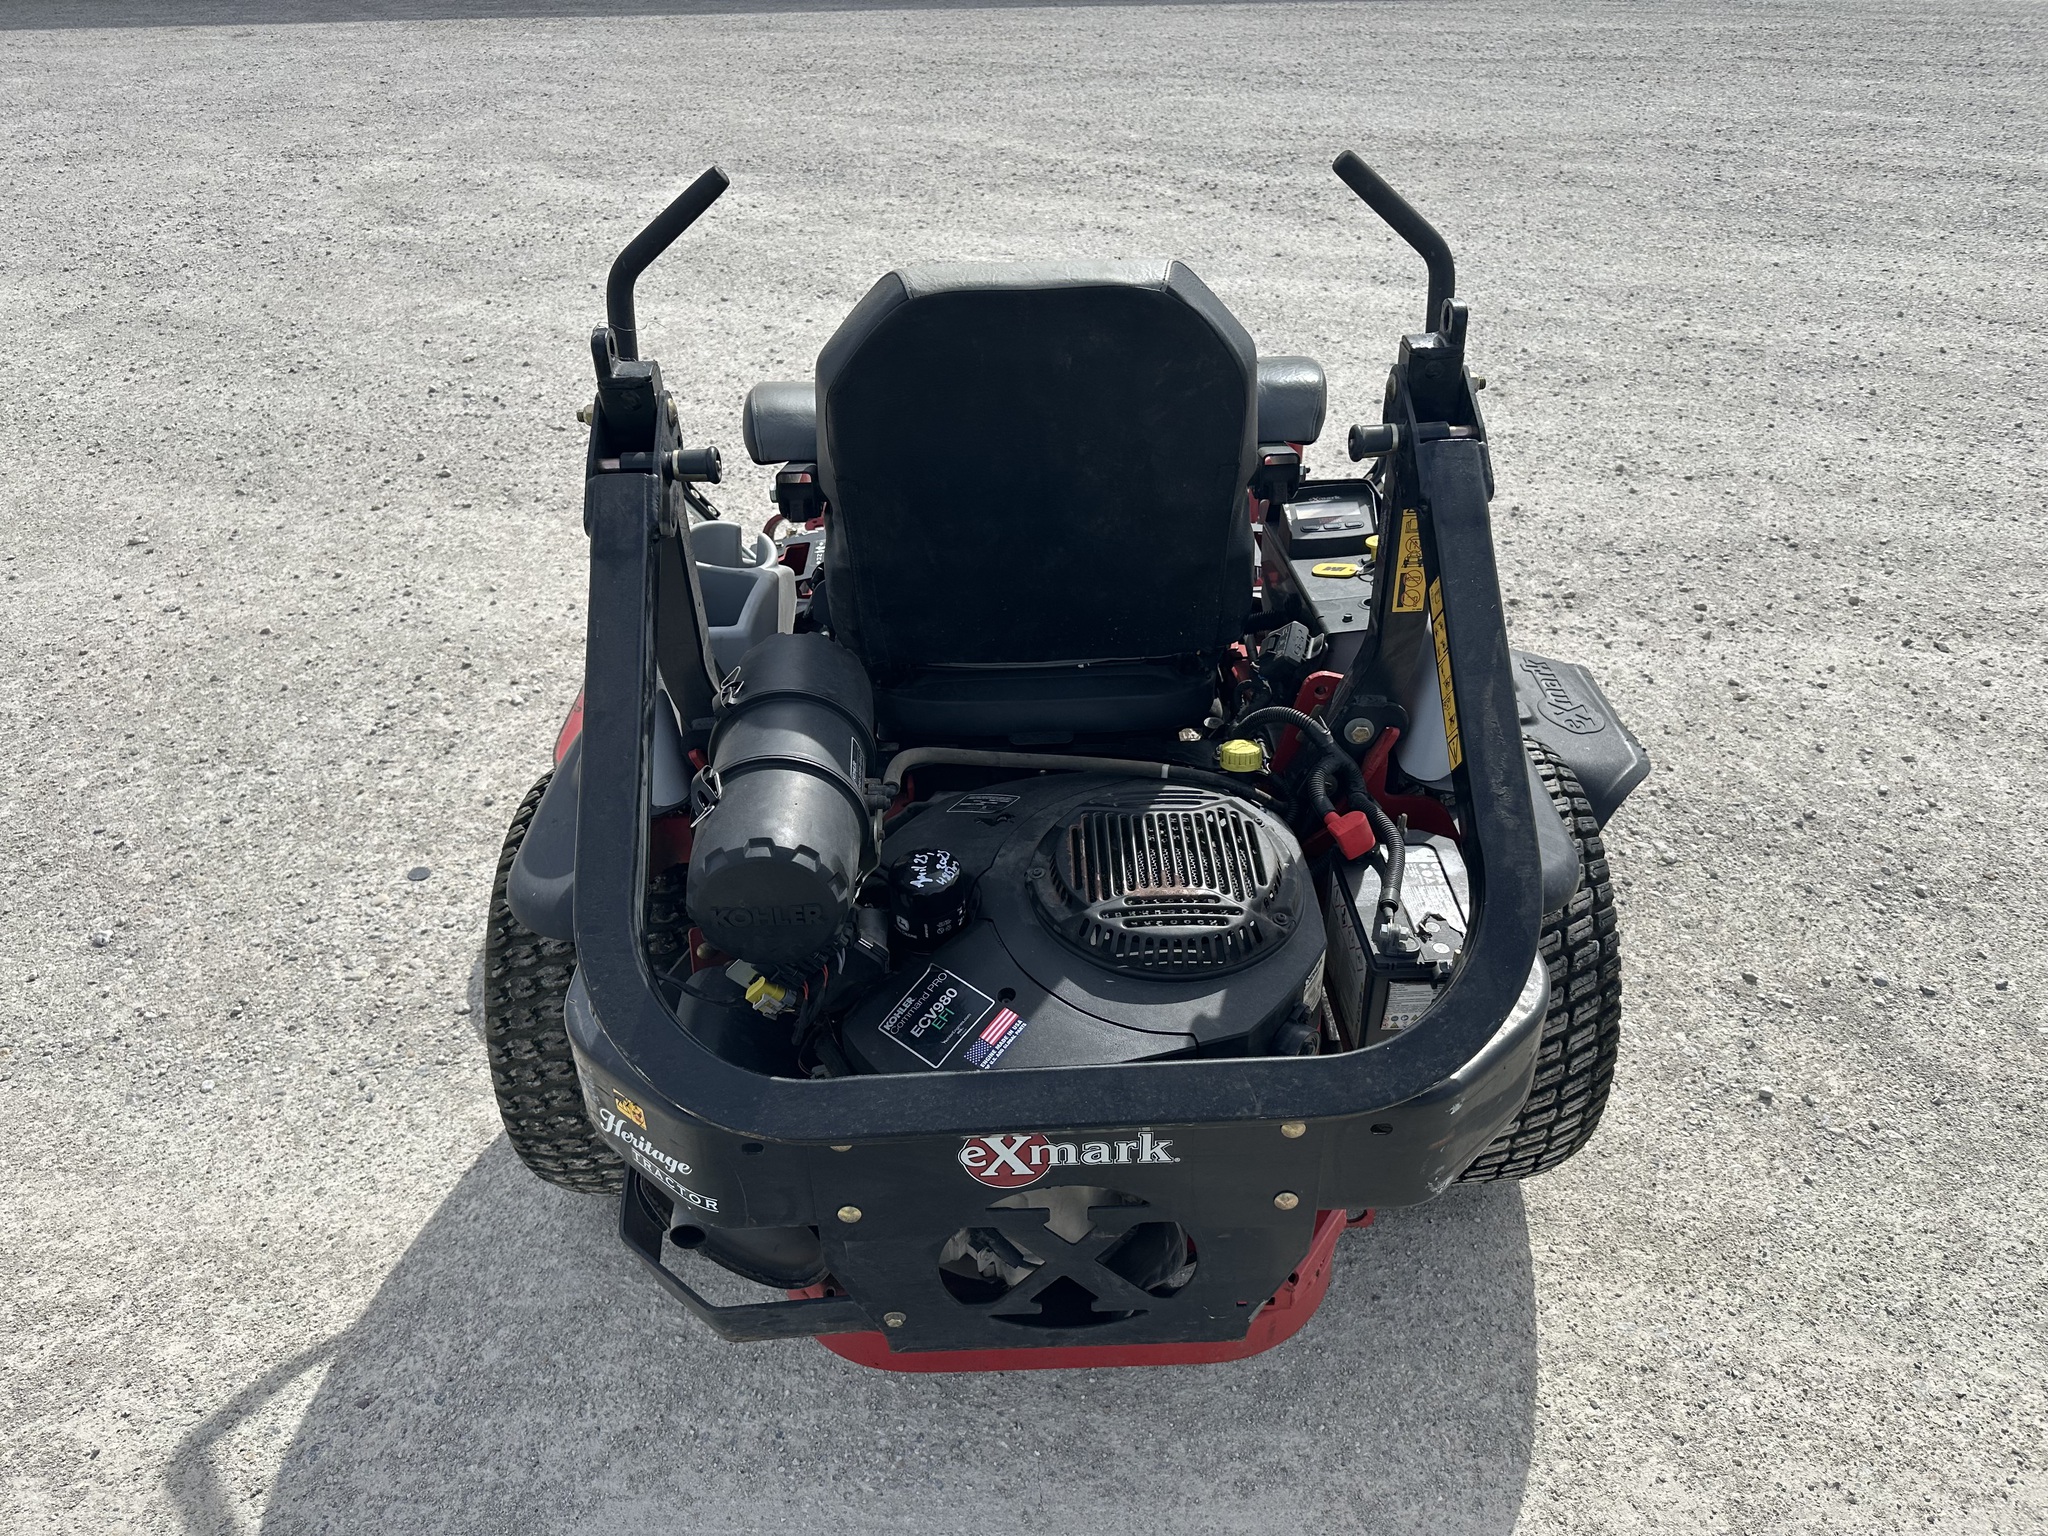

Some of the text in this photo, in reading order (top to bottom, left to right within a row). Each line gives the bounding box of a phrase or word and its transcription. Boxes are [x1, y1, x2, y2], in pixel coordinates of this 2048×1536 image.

[710, 903, 824, 927] KOHLER
[883, 996, 916, 1031] KOHLER
[890, 972, 948, 1035] Command PRO
[909, 987, 958, 1038] ECV980
[931, 1007, 955, 1030] EFI
[979, 1049, 998, 1068] ENGINE
[994, 1034, 1010, 1051] MADE
[1011, 1019, 1023, 1031] USA
[600, 1108, 693, 1175] Heritage
[631, 1149, 719, 1211] TRACTOR
